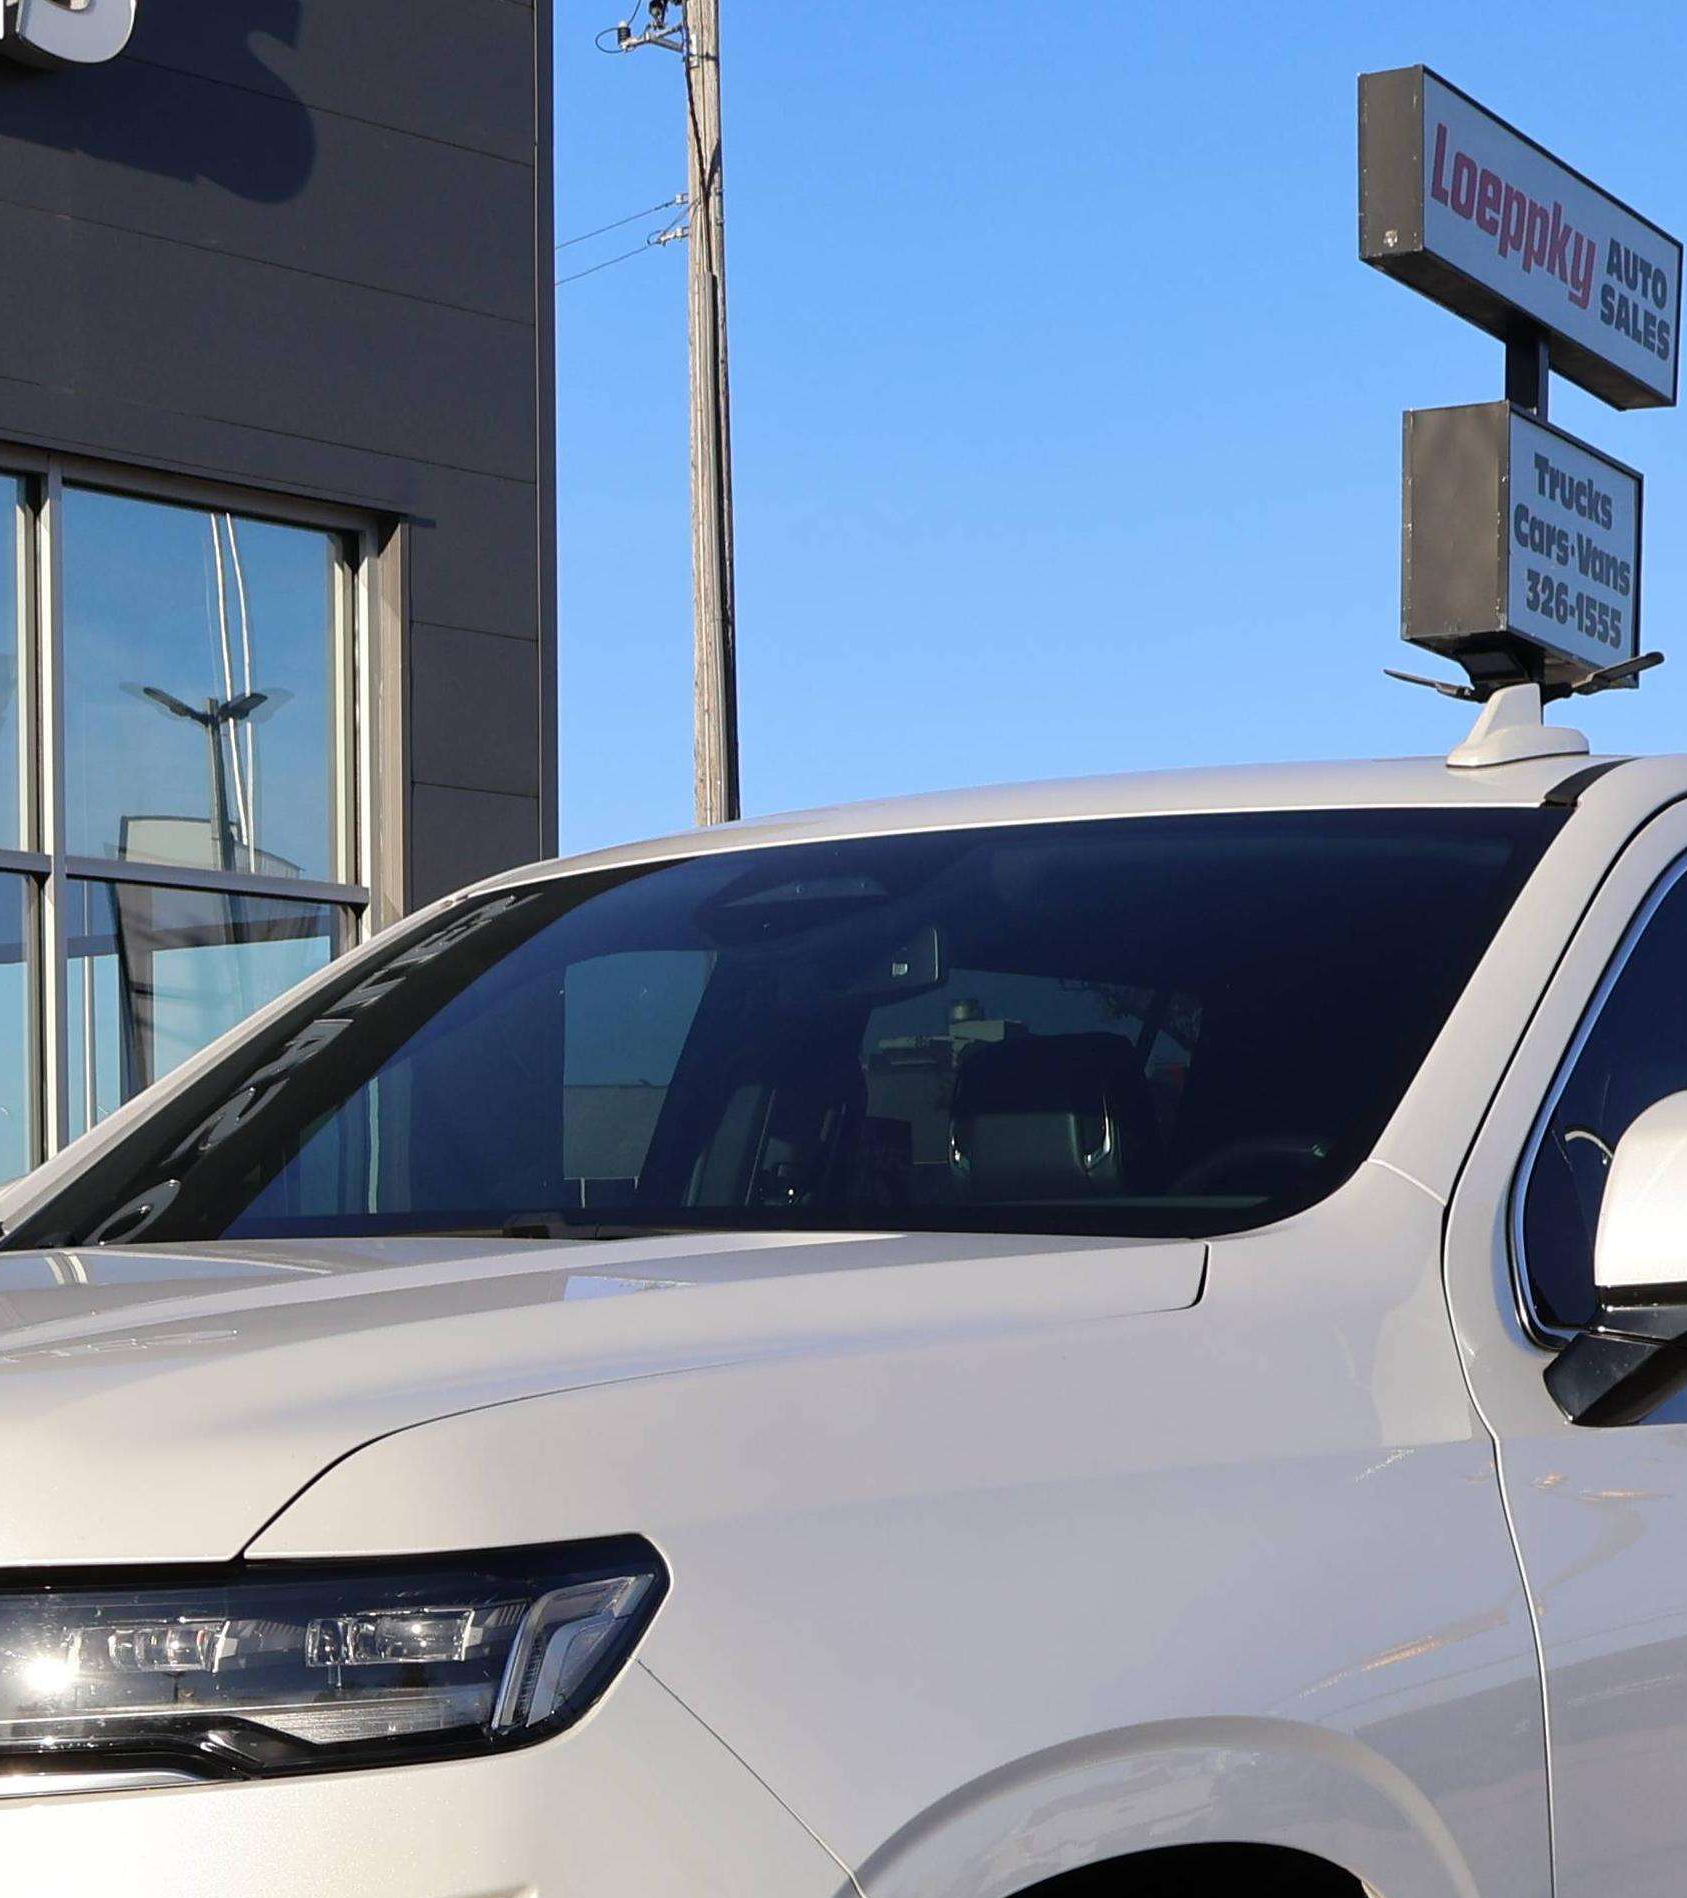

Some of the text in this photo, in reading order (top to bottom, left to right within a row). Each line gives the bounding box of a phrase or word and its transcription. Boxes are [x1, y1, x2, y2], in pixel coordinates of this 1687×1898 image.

[1430, 122, 1599, 310] Loeppky
[1605, 236, 1669, 312] AUTO
[1599, 283, 1671, 363] SALES
[1533, 452, 1614, 532] Trucks
[1525, 569, 1623, 652] 326-1555
